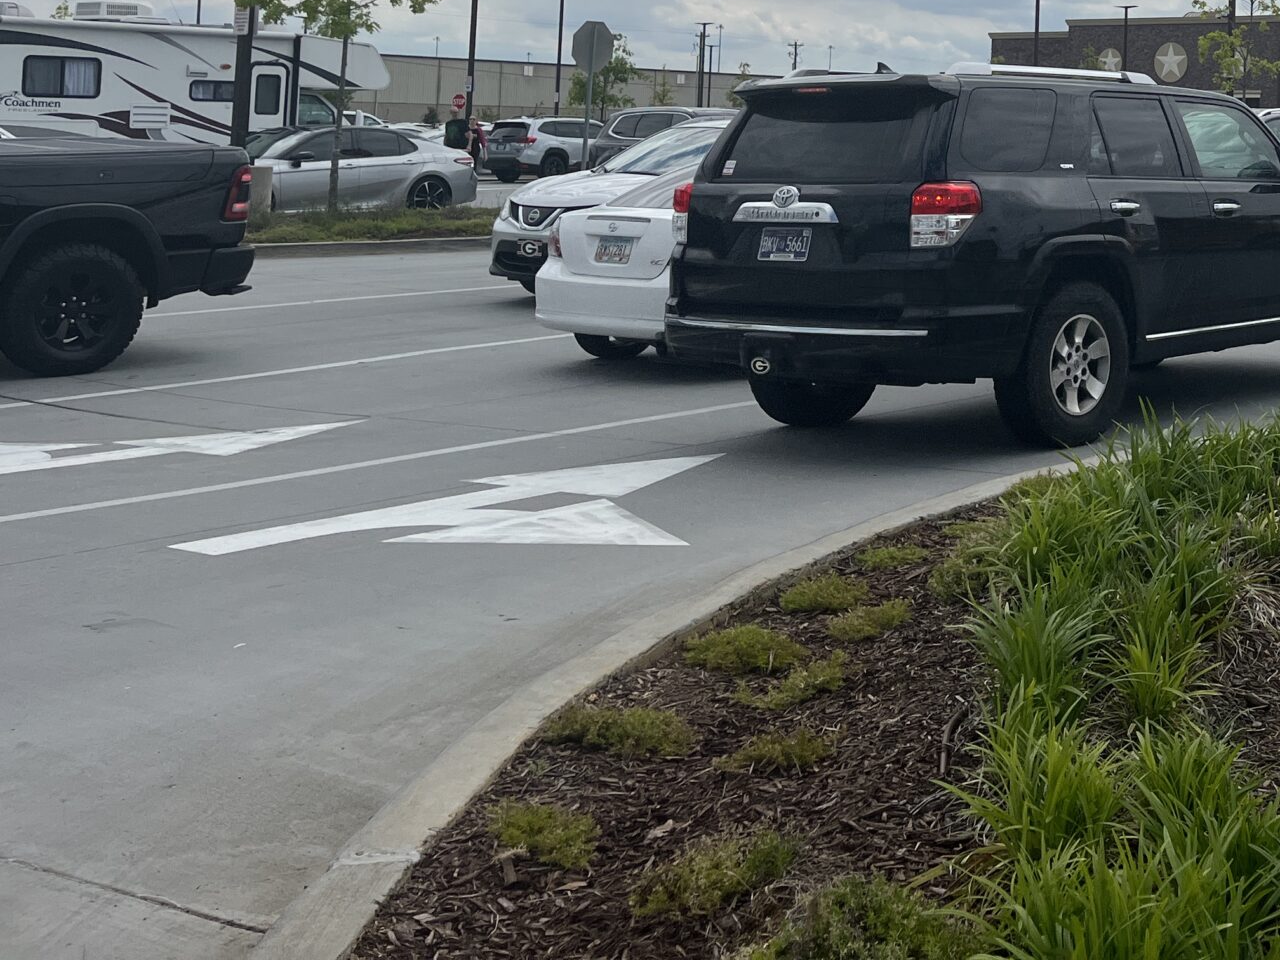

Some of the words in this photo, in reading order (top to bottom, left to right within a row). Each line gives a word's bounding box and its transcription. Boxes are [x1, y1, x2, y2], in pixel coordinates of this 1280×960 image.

[4, 98, 61, 108] Coachmen
[453, 98, 466, 106] STOP
[785, 236, 807, 252] 5661
